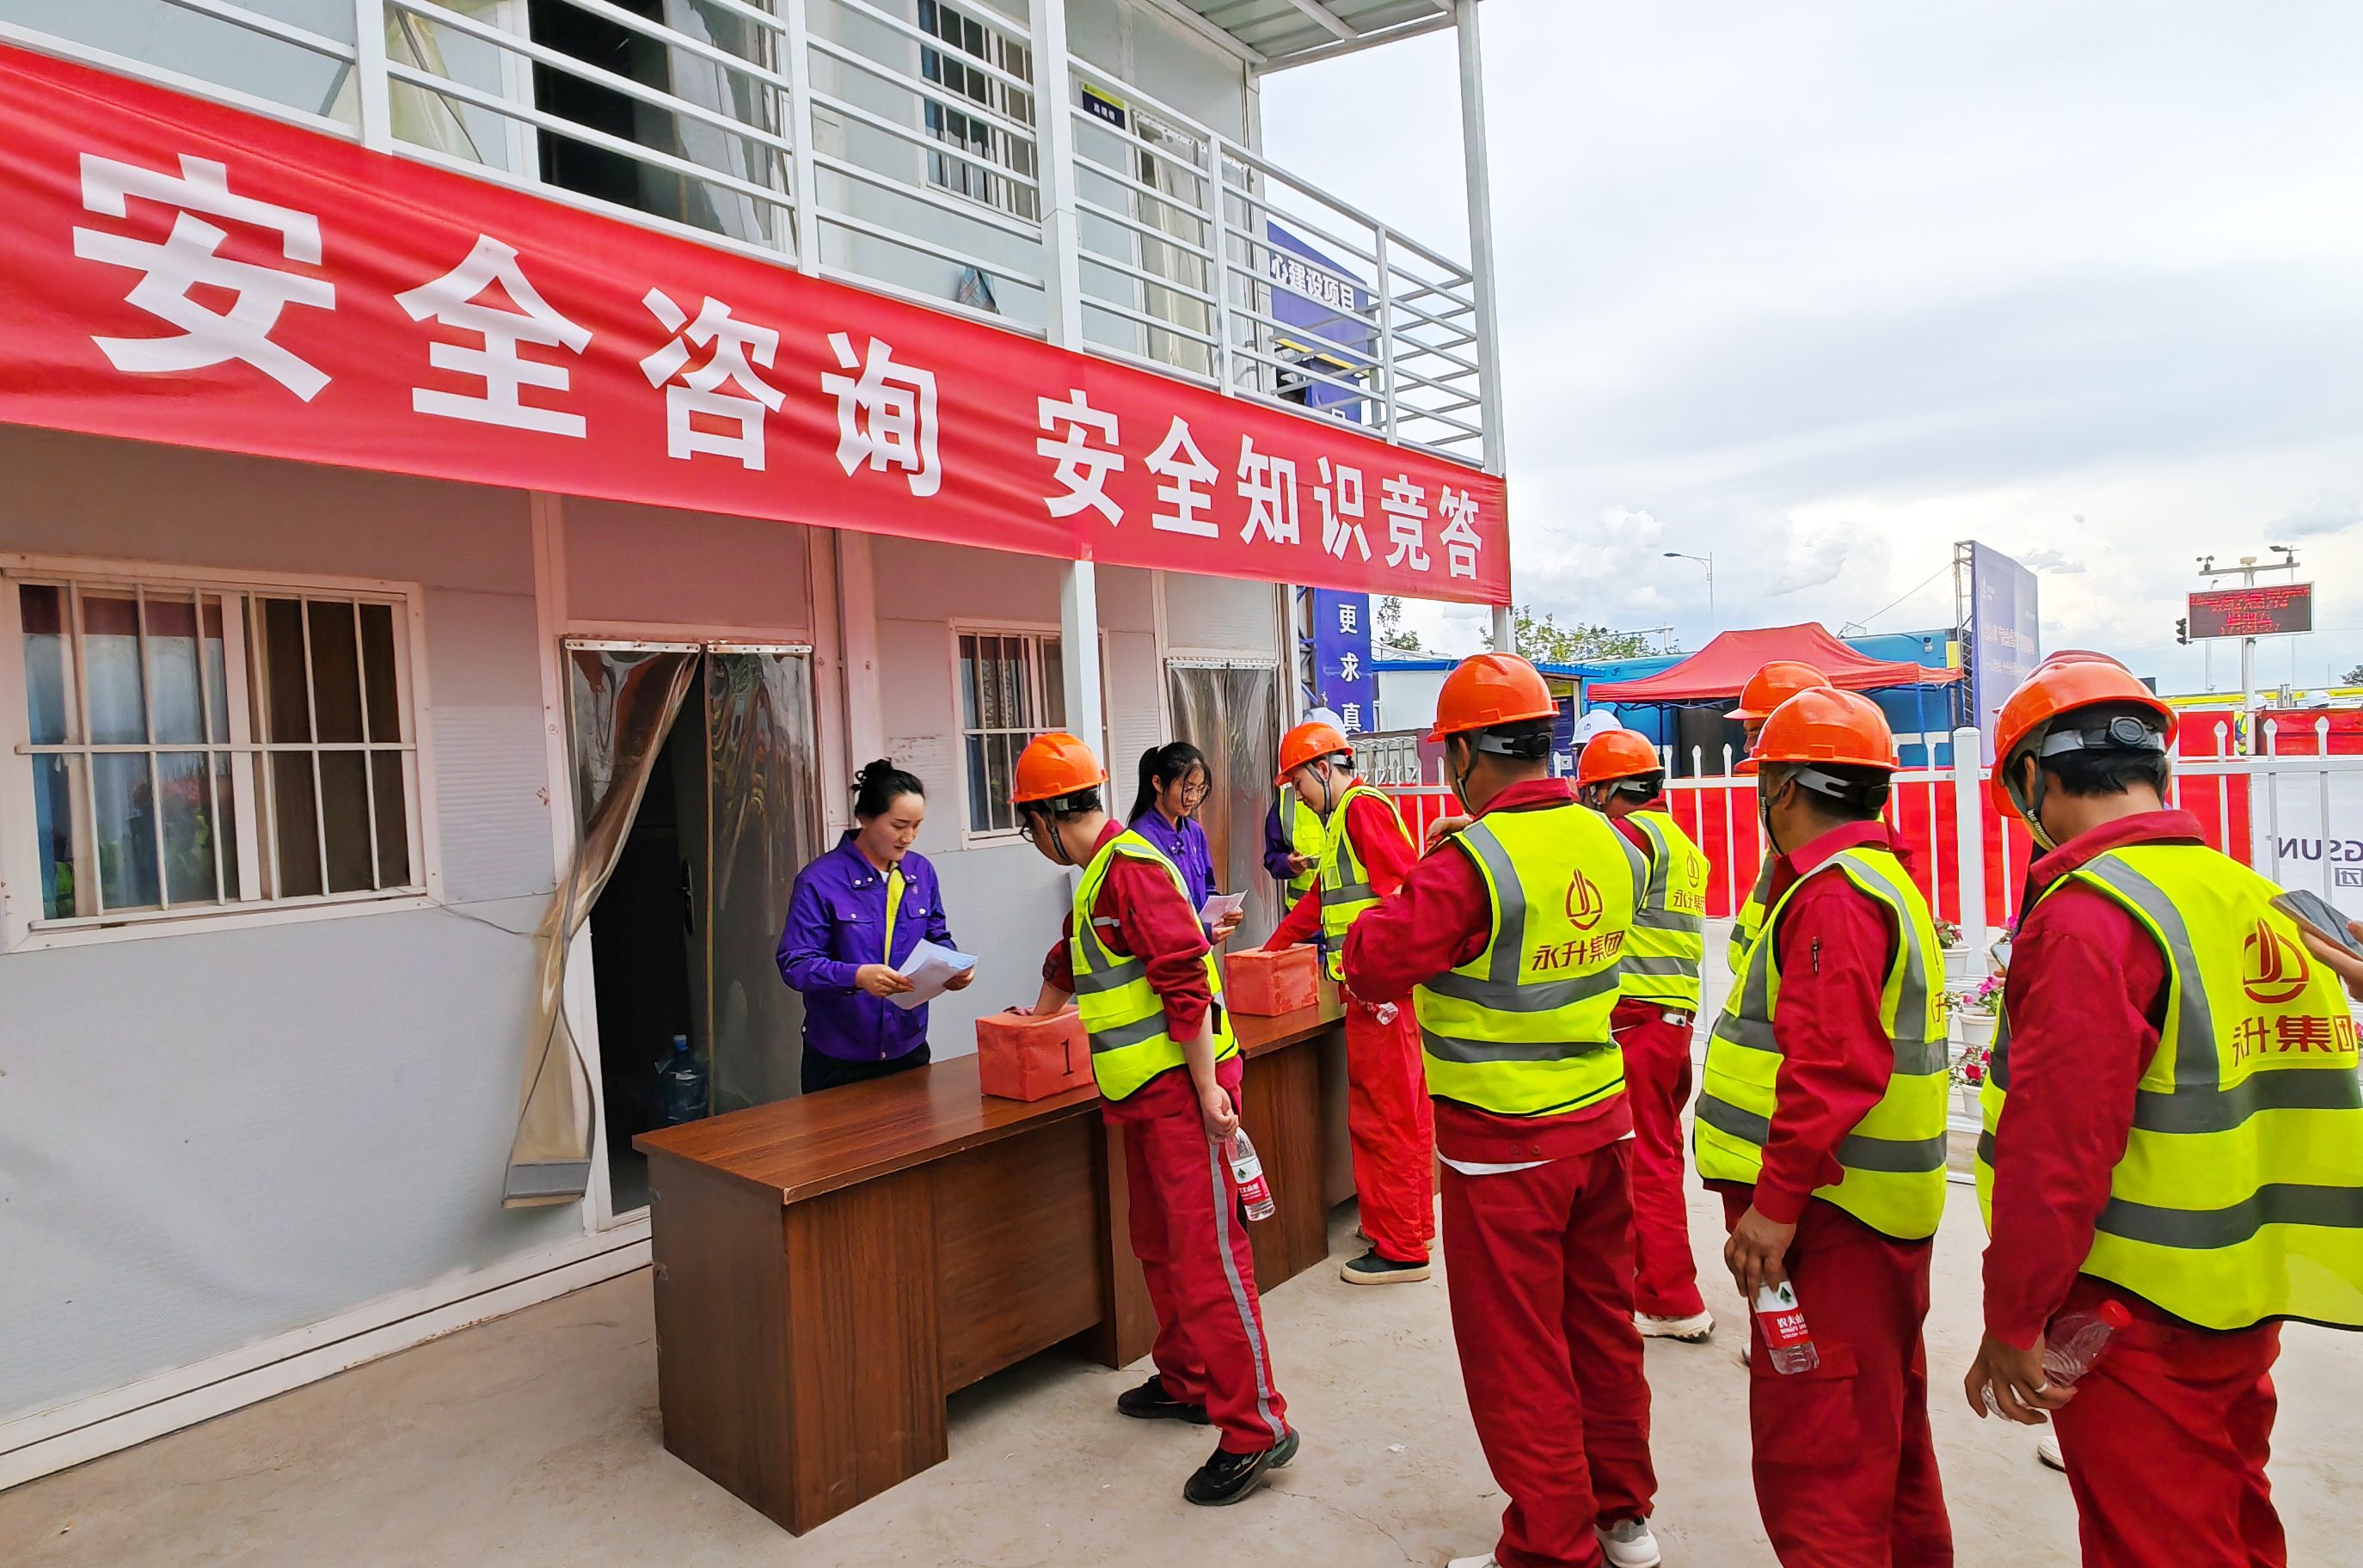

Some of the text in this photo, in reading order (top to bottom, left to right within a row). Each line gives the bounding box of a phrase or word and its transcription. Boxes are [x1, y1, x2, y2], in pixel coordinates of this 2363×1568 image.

[72, 152, 1483, 581] 安全咨询 安全知识竞答
[1531, 930, 1625, 971] 永升集团
[1060, 1037, 1074, 1076] 1
